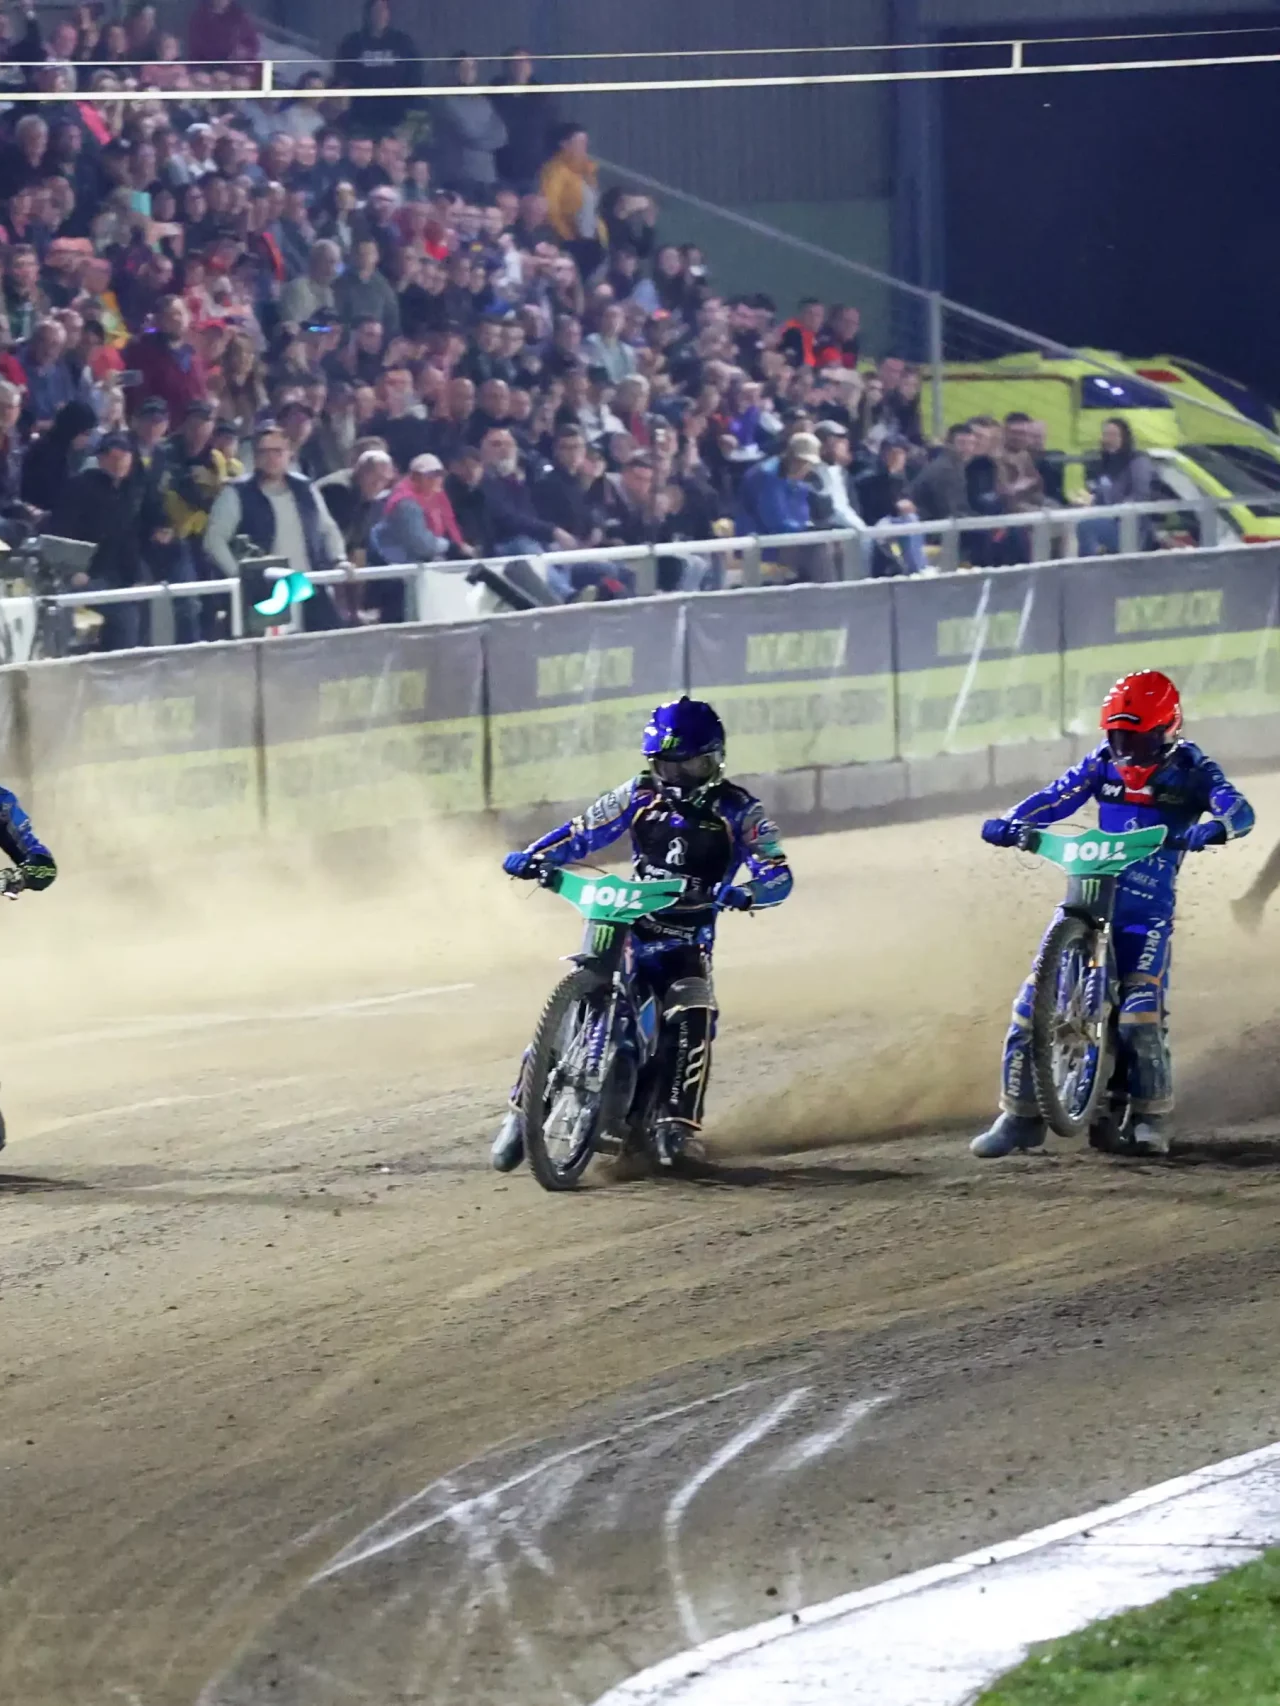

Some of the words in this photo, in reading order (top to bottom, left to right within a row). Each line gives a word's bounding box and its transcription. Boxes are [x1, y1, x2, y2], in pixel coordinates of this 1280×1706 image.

[1063, 841, 1127, 862] BOLL
[579, 884, 643, 909] BOLL
[1137, 929, 1162, 971] ORLEN
